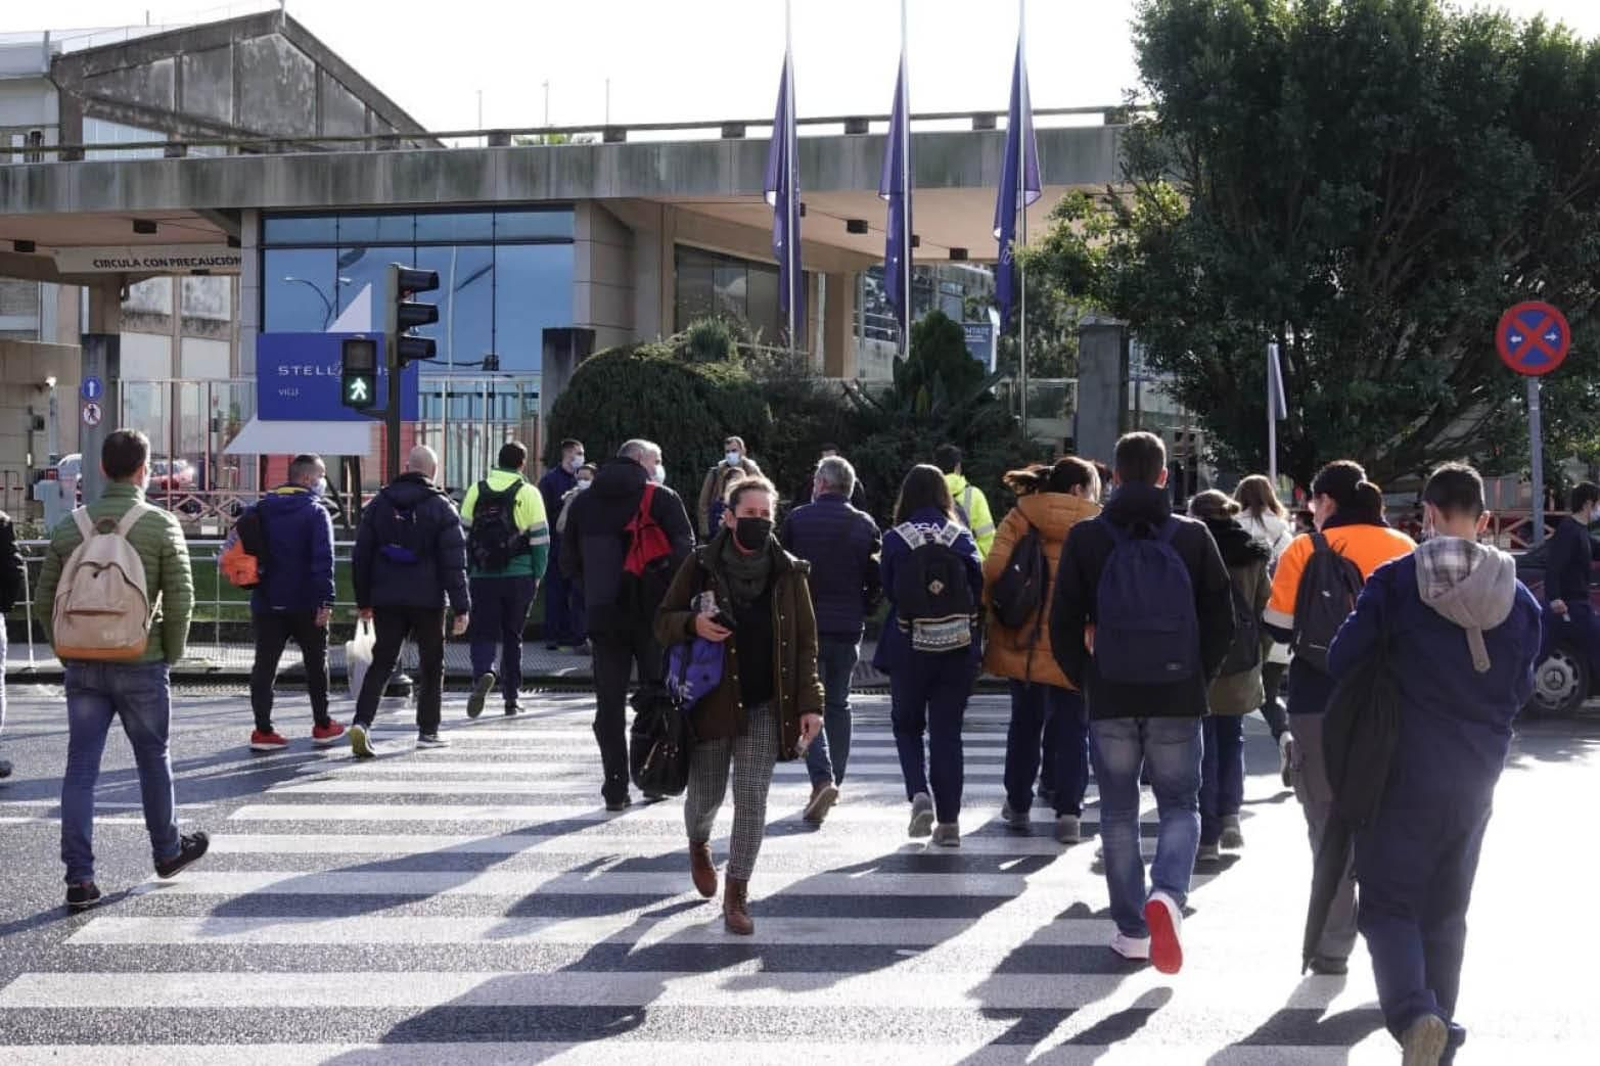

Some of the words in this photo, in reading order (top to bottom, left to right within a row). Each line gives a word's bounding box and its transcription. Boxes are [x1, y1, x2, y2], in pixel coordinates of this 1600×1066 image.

[93, 258, 140, 268] CIRCULA
[144, 257, 168, 267] CON
[278, 365, 389, 376] STELLI
